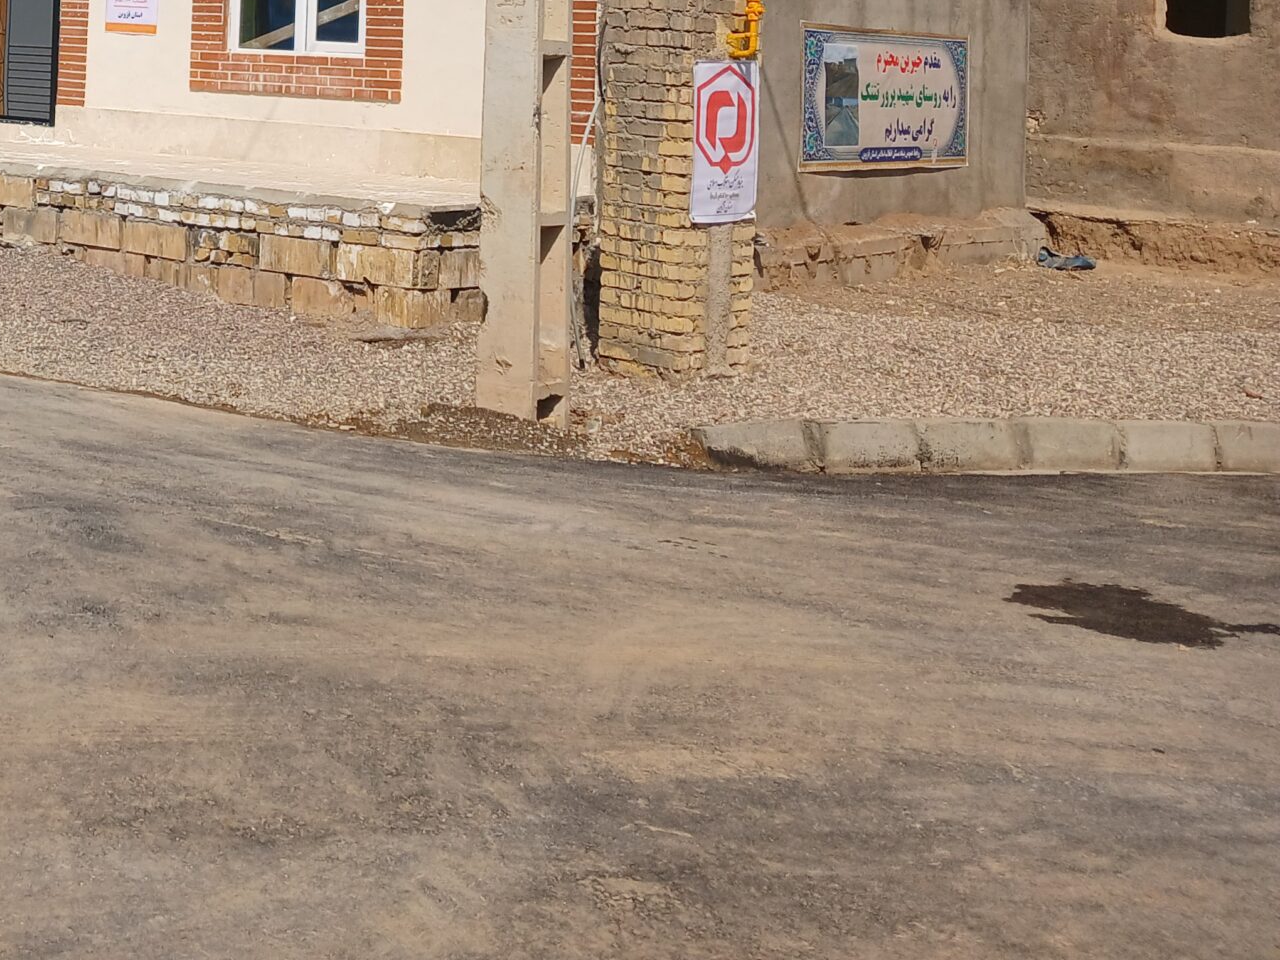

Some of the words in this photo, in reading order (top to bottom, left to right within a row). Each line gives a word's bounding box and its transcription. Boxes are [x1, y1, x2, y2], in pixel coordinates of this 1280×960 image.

[876, 50, 899, 73] محترم
[900, 50, 923, 74] خیرین
[923, 51, 941, 74] مقدم
[915, 83, 942, 109] روستای
[942, 88, 950, 108] به
[950, 84, 957, 109] را
[911, 117, 935, 142] گرامی
